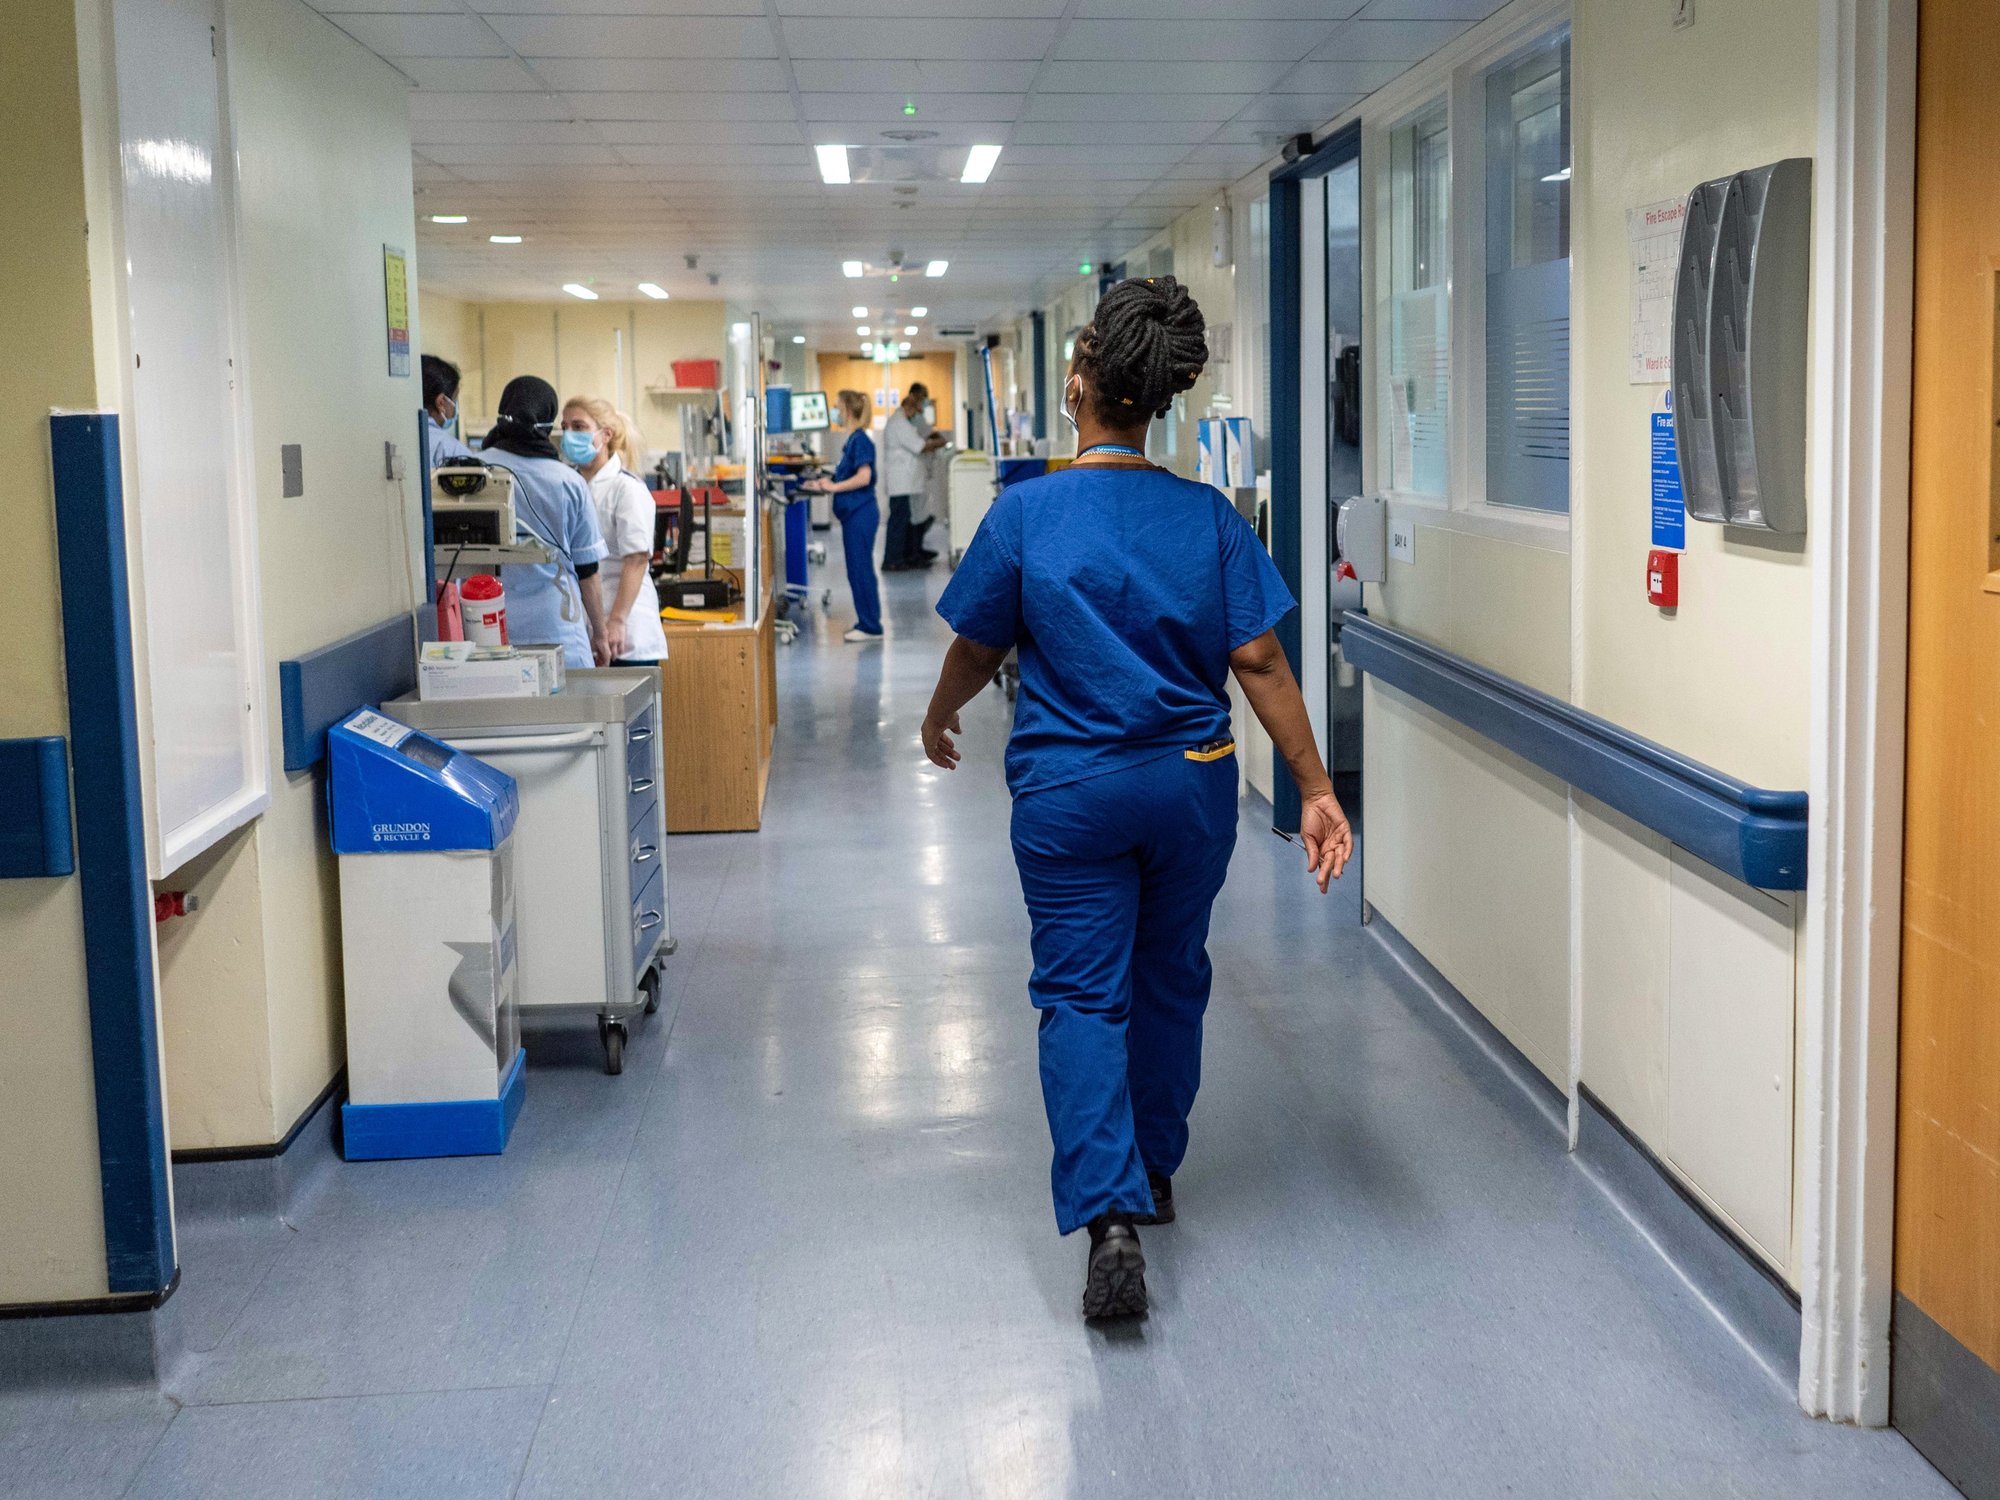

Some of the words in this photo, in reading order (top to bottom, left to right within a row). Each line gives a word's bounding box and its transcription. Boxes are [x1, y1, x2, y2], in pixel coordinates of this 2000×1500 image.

[1646, 212, 1656, 226] Fire
[1658, 209, 1677, 223] Escape
[1646, 357, 1659, 370] Ward
[1656, 415, 1666, 428] Fire
[373, 823, 430, 832] GRUNDON
